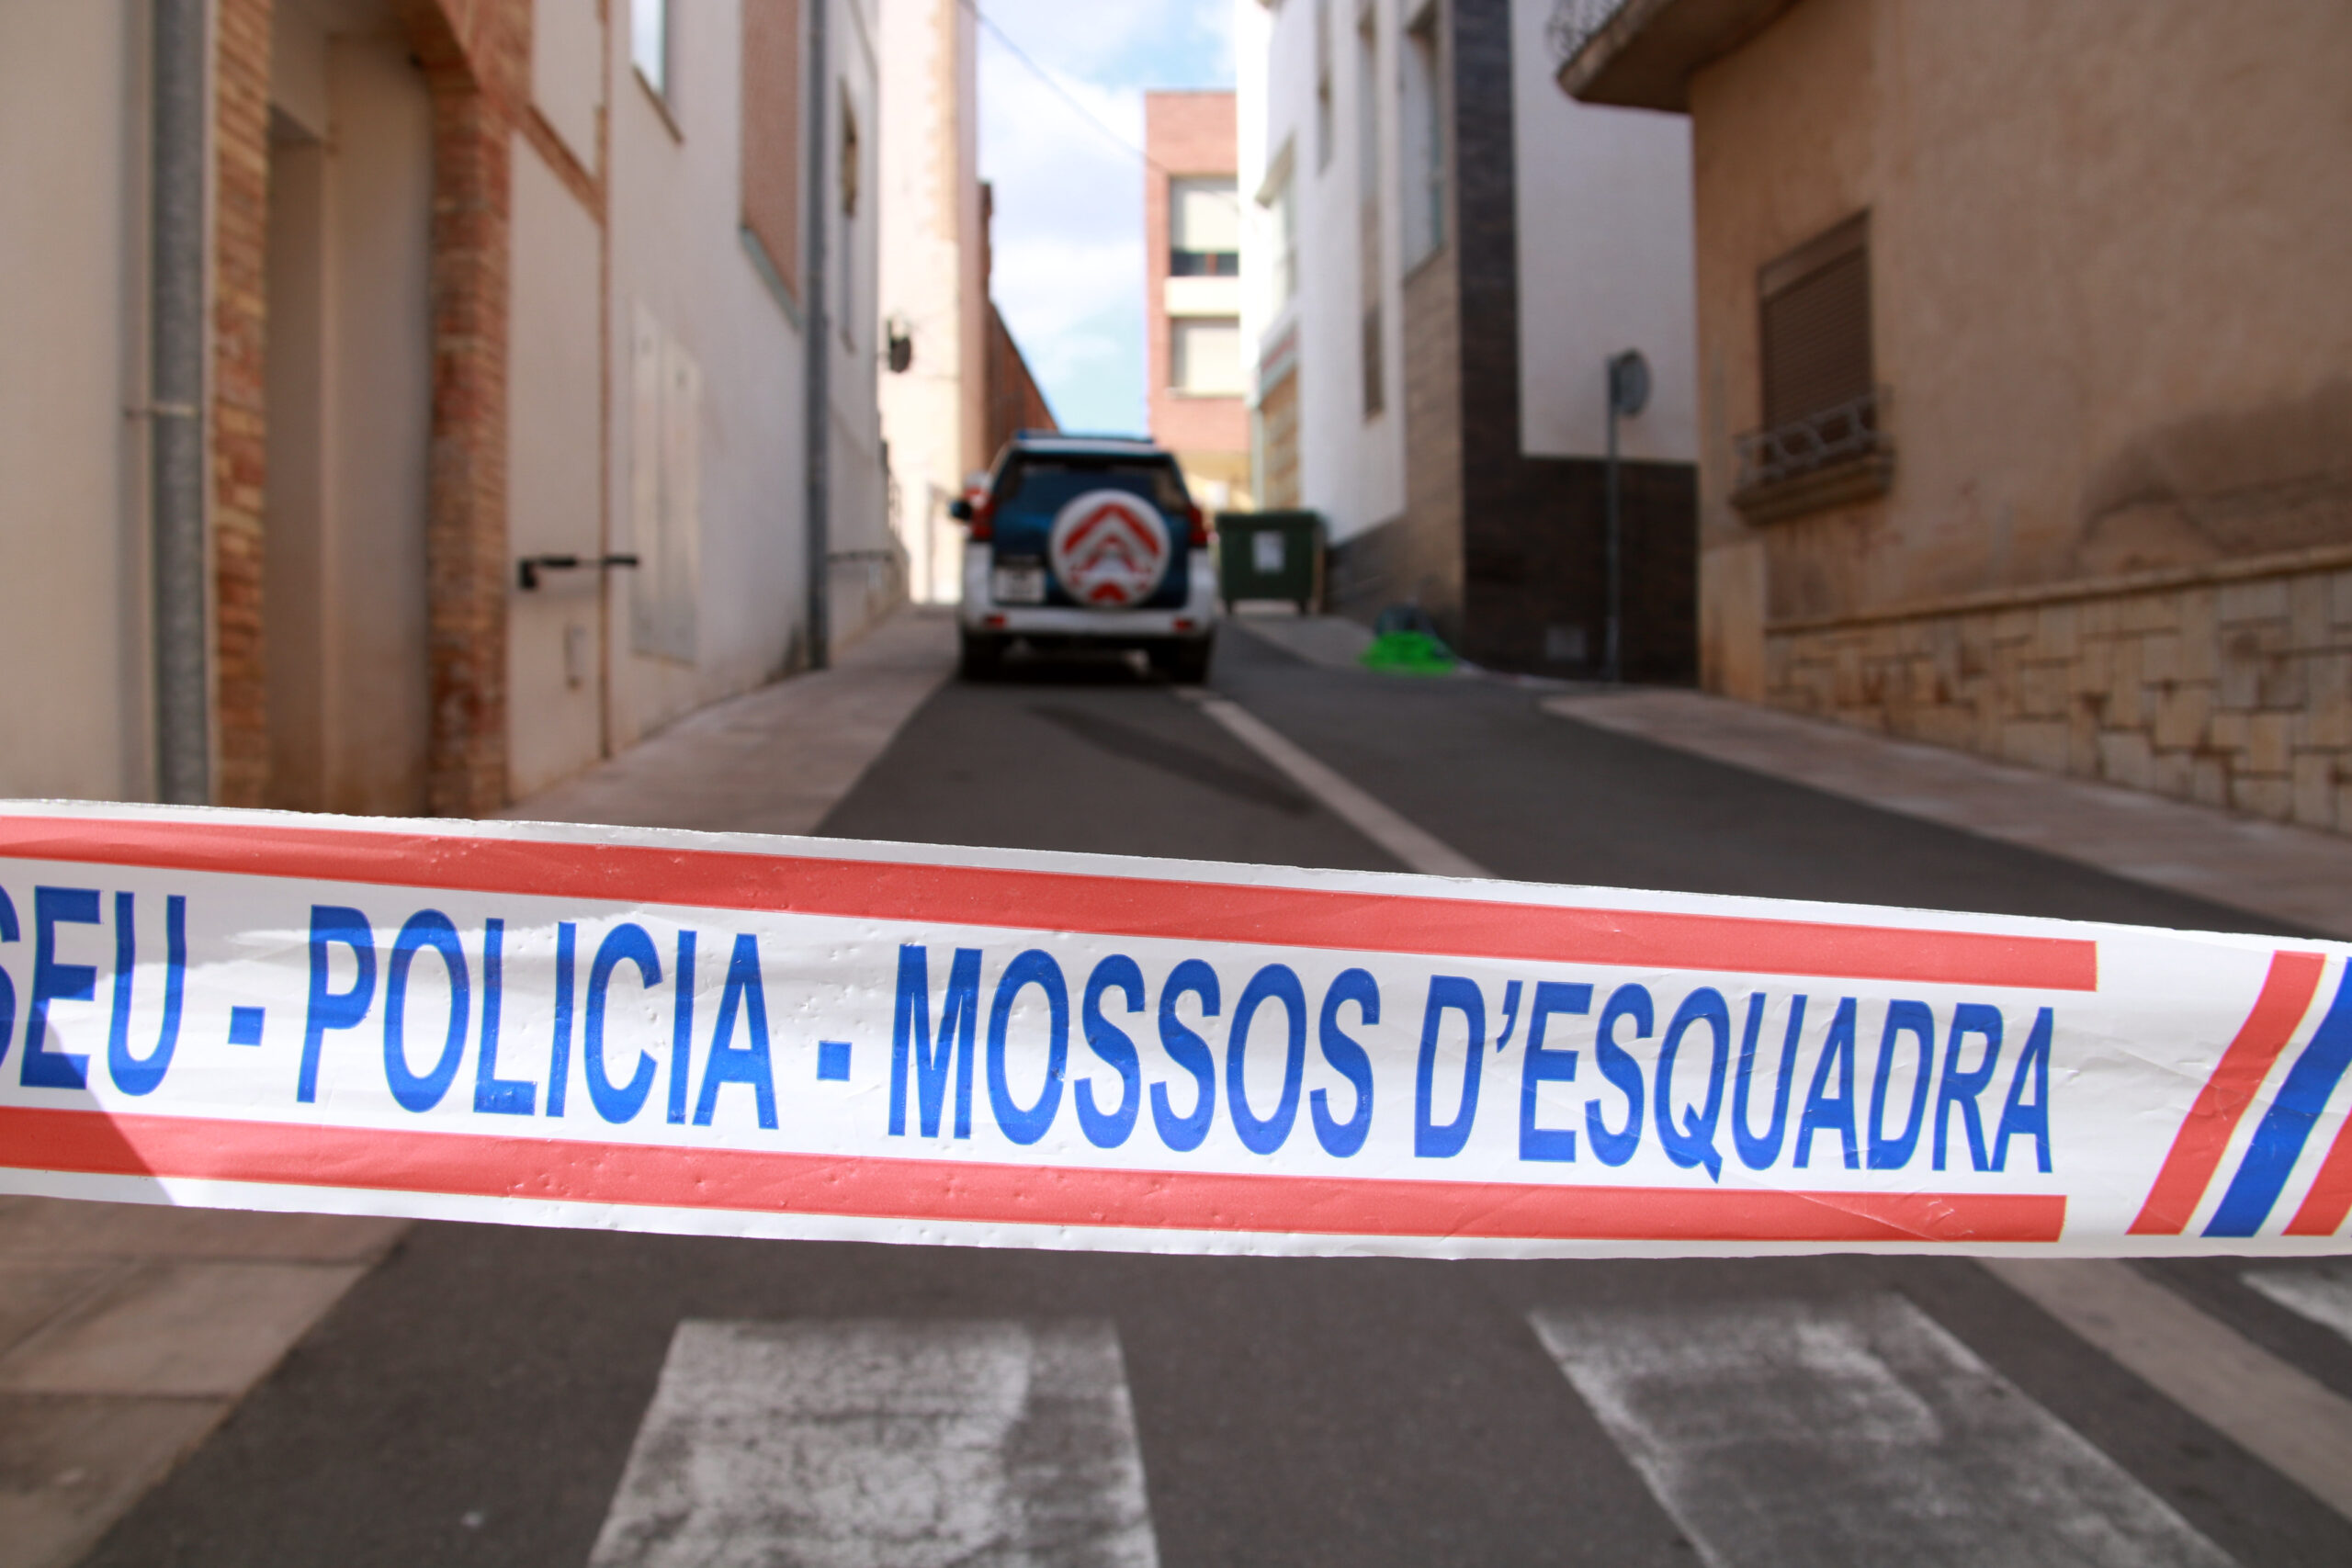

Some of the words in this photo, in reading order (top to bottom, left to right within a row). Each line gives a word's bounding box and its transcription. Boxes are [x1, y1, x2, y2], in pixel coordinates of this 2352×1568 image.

[0, 885, 187, 1097] EU
[296, 905, 779, 1130] POLICIA
[888, 943, 1381, 1158] MOSSOS
